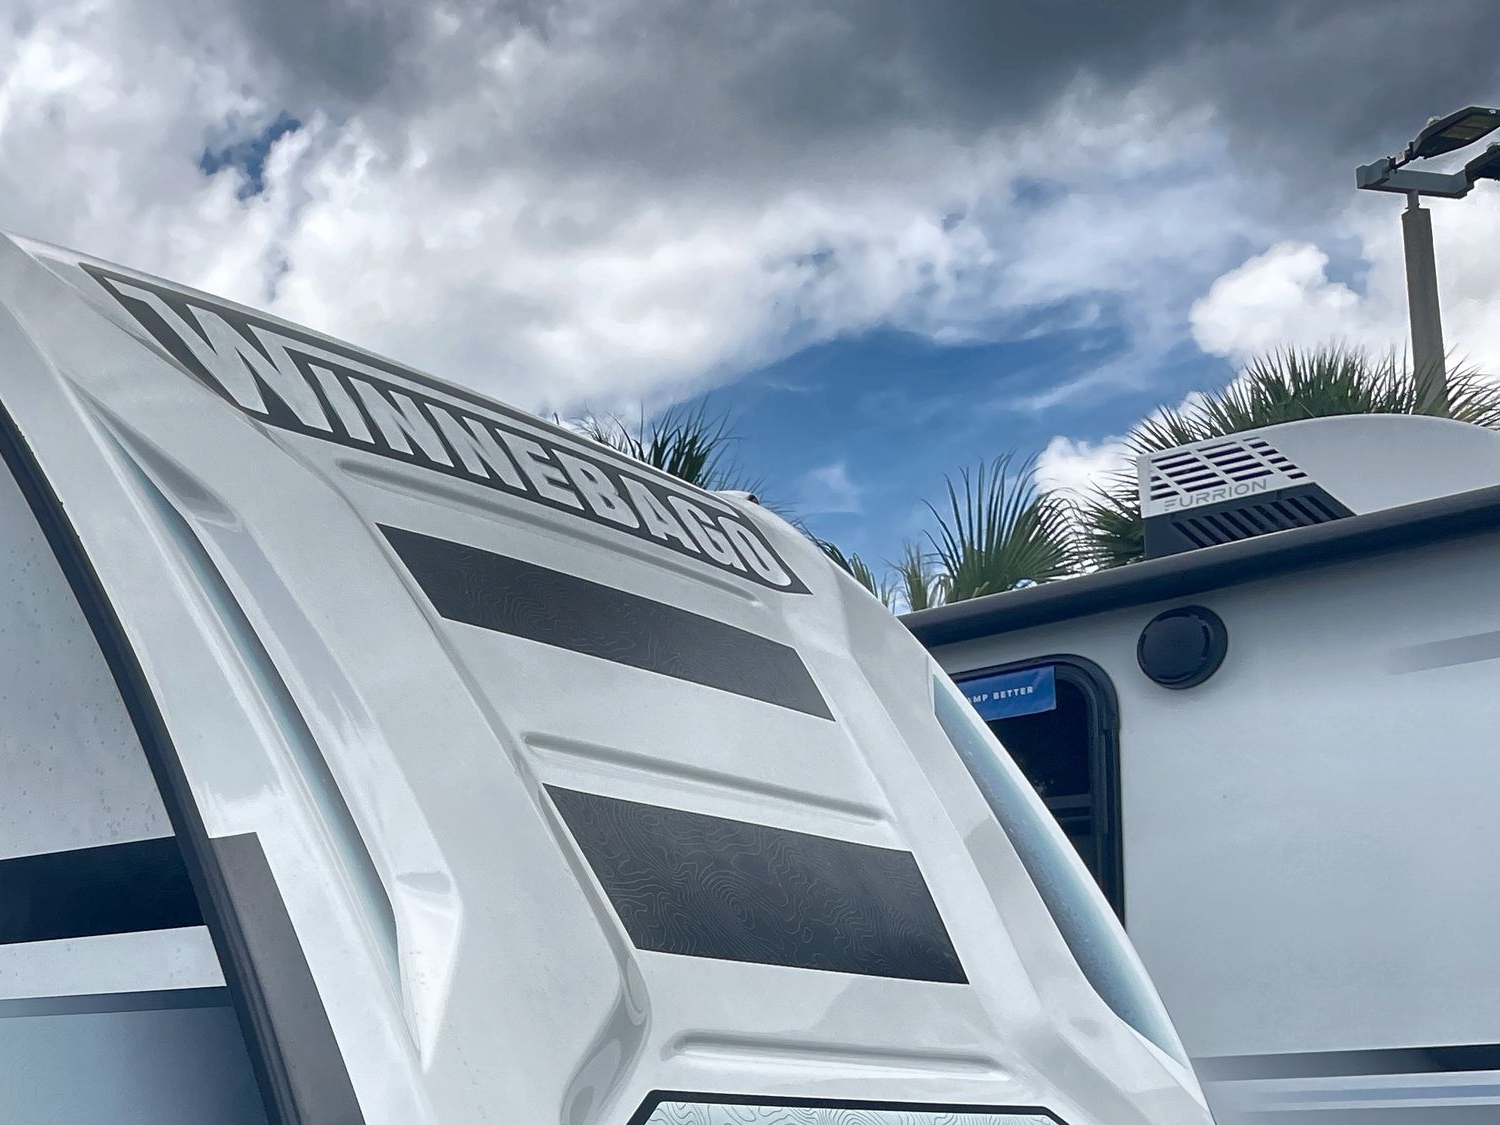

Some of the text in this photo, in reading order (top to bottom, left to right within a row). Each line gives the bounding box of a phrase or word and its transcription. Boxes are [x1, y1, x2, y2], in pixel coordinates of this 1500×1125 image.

[103, 277, 794, 588] WINNEBAGO
[1164, 479, 1267, 512] FURRION
[993, 686, 1033, 700] BETTER
